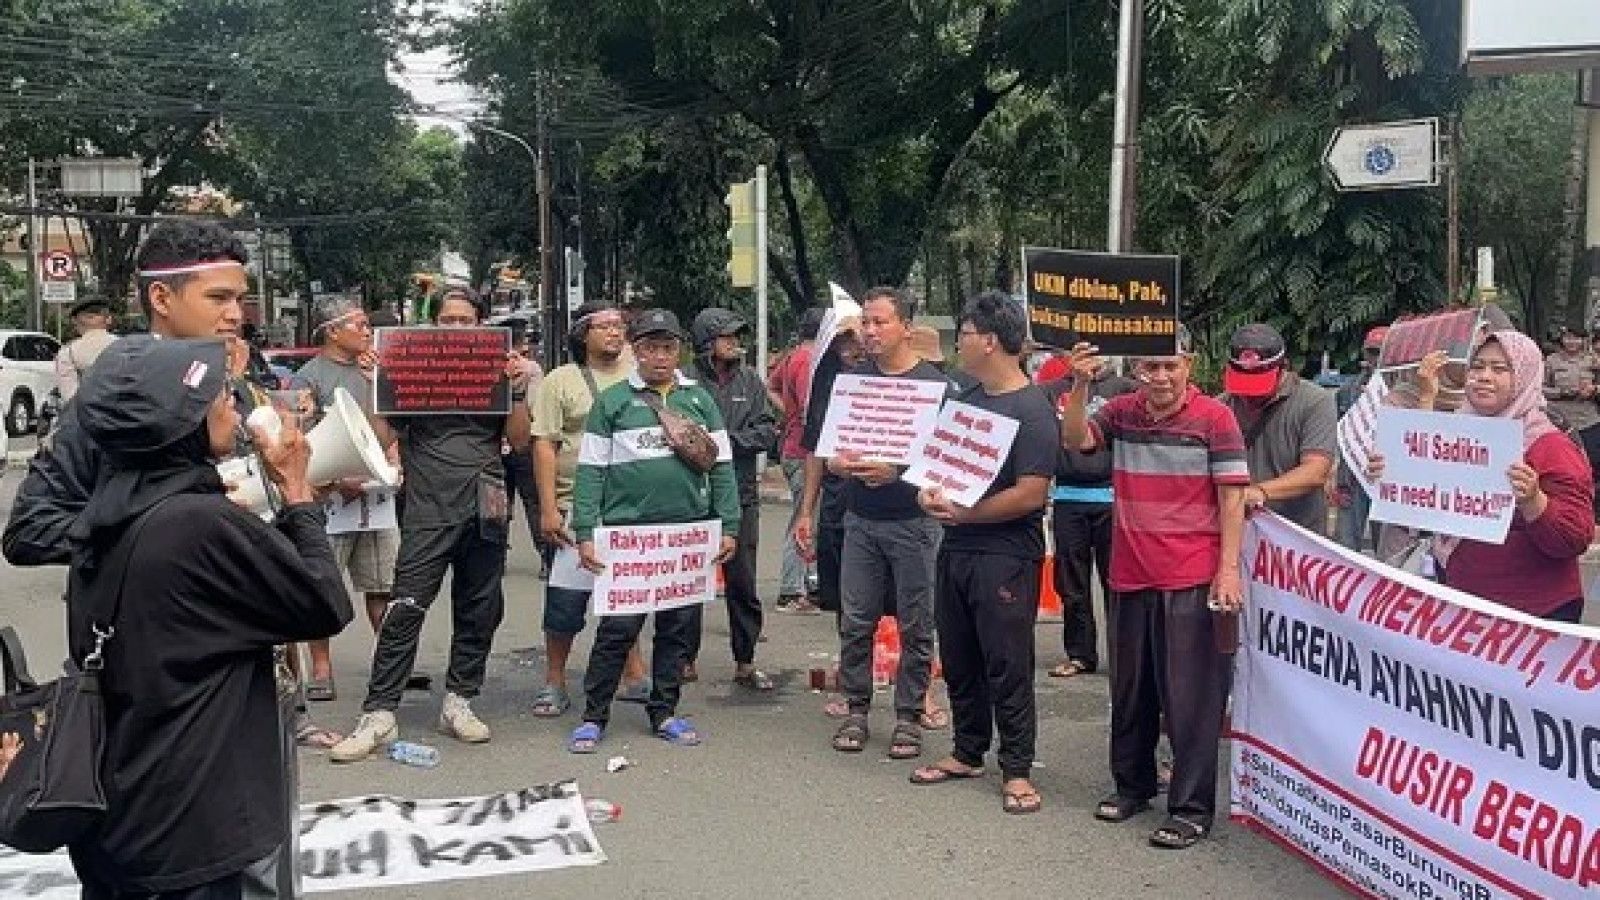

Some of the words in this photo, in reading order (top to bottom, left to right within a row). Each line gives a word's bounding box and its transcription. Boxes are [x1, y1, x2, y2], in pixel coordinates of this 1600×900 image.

[1034, 271, 1065, 296] UKM
[1069, 276, 1126, 306] dibina,
[1129, 281, 1167, 306] Pak,
[1072, 312, 1174, 334] dibinasakan
[1432, 434, 1489, 468] Sadikin
[1379, 482, 1398, 503] we
[1400, 484, 1436, 508] need
[1440, 492, 1449, 511] u
[609, 530, 664, 556] Rakyat
[668, 528, 709, 548] usaha
[612, 560, 677, 582] pemprov
[681, 552, 707, 572] DKI
[607, 589, 651, 611] gusur
[1358, 577, 1561, 688] MENJERIT,
[1258, 608, 1362, 692] KARENA
[1369, 649, 1525, 760] AYAHNYA
[1356, 727, 1474, 826] DIUSIR
